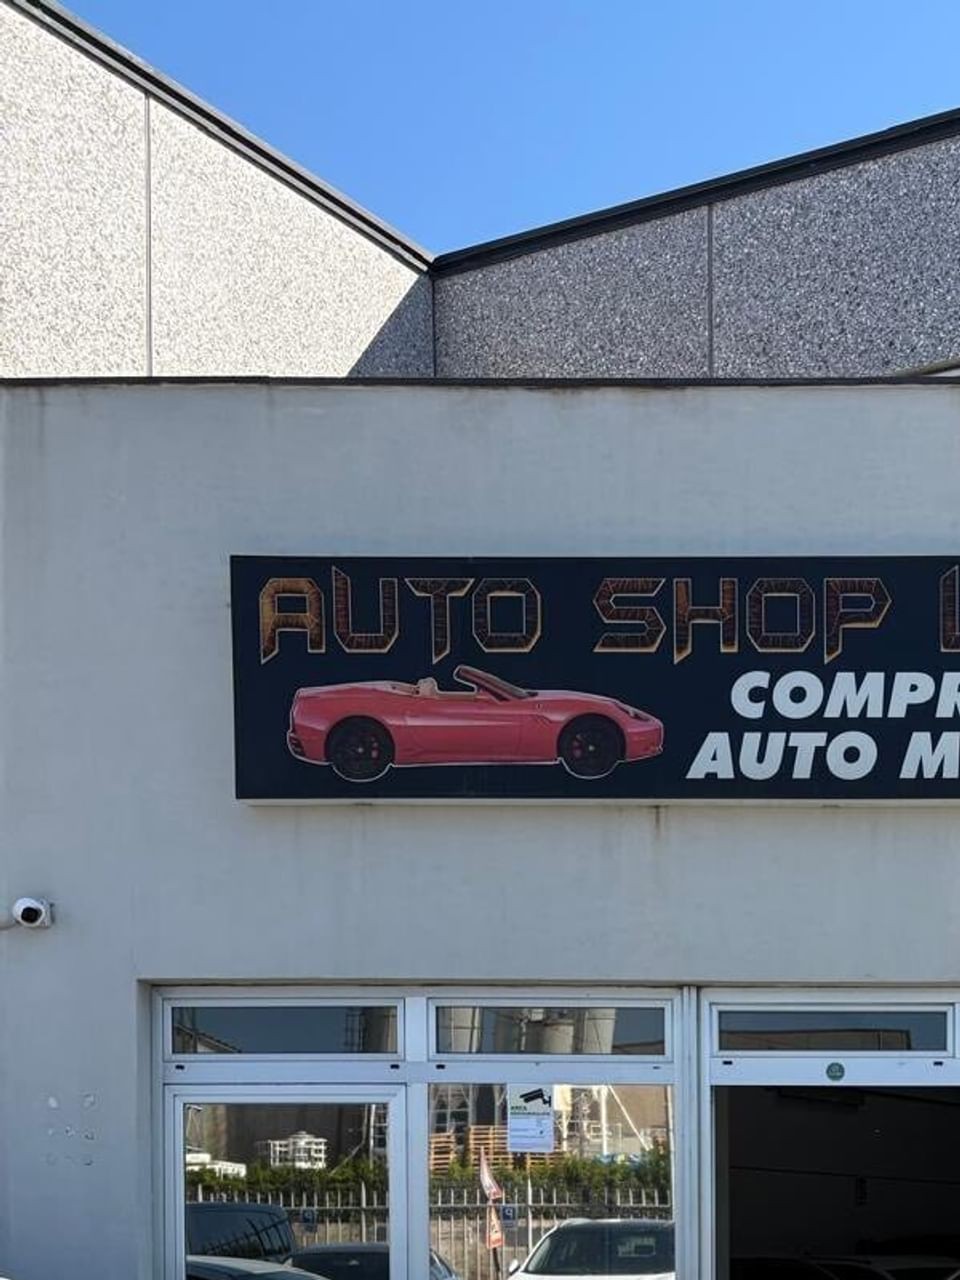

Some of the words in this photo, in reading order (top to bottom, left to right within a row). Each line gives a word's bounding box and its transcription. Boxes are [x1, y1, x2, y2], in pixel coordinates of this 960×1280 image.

[259, 566, 542, 664] AUTO
[593, 577, 892, 665] SHOP
[686, 732, 878, 781] AUTO
